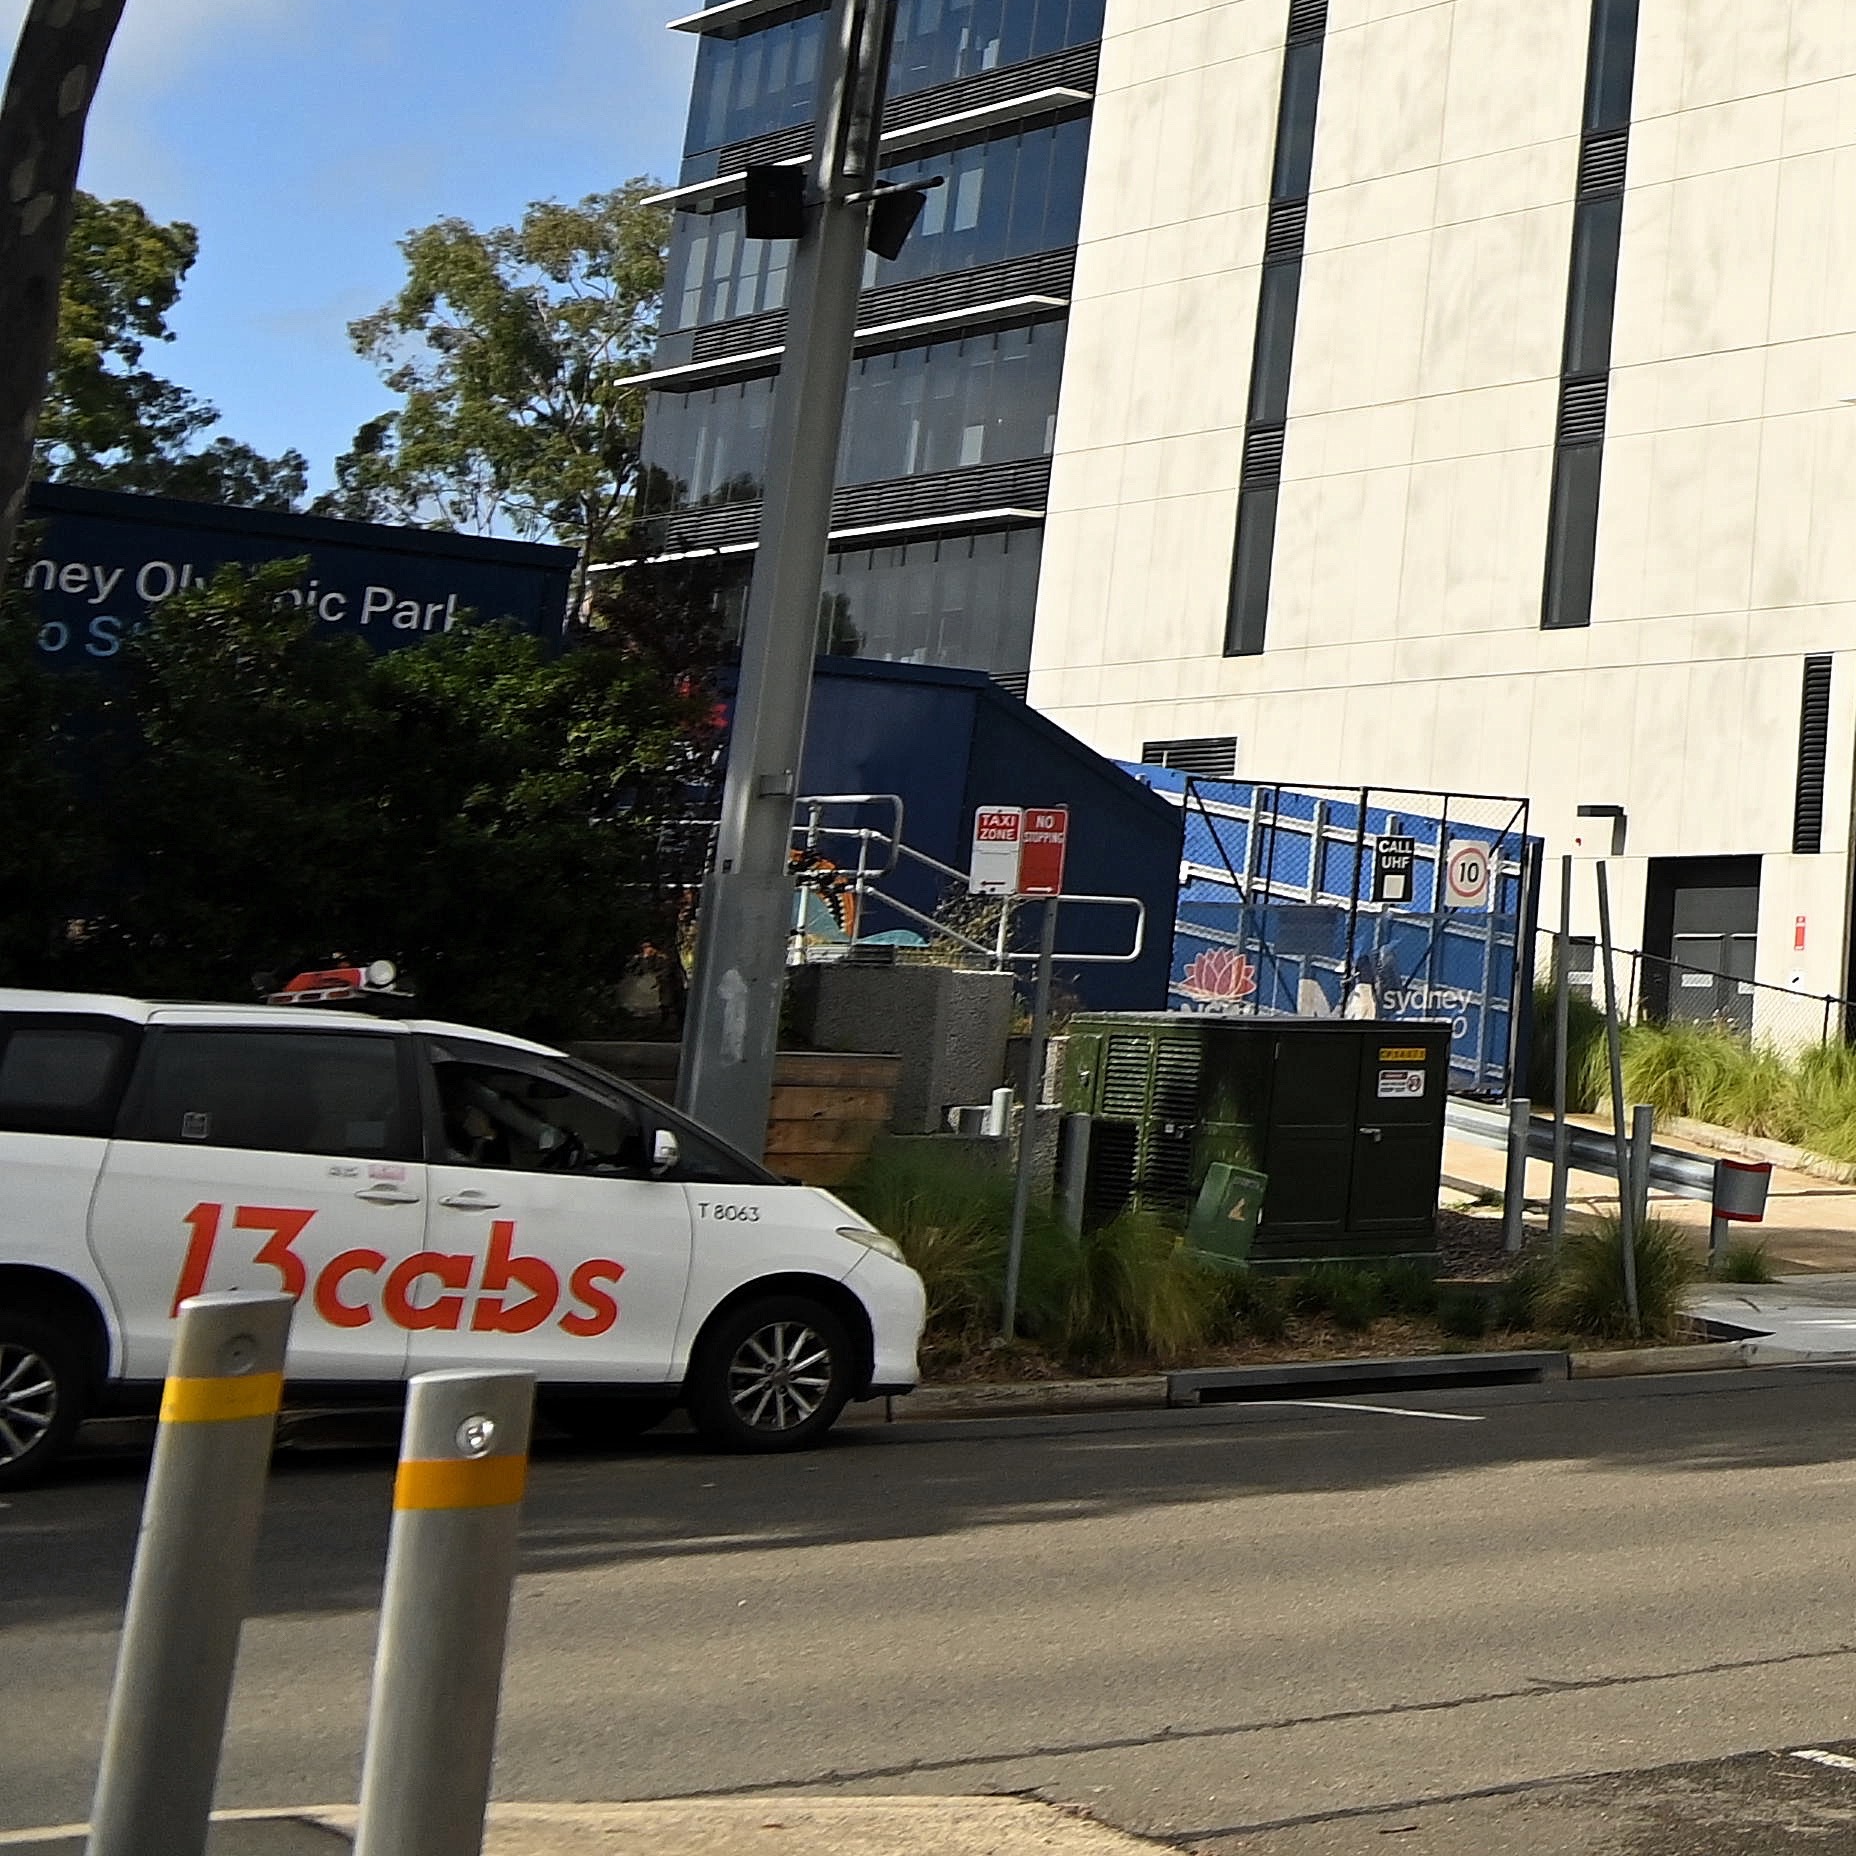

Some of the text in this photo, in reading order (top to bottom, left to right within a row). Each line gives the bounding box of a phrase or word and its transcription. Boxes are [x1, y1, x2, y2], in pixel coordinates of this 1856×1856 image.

[981, 815, 1016, 826] TAXI
[1036, 815, 1055, 829] NO
[979, 828, 1016, 840] ZONE
[1023, 832, 1064, 843] STOPPING
[1378, 840, 1412, 854] CALL
[1381, 855, 1411, 870] UHF
[1459, 862, 1479, 883] 10
[1383, 984, 1473, 1014] sydney
[698, 1203, 760, 1222] T 8063
[170, 1201, 628, 1338] 13cabs
